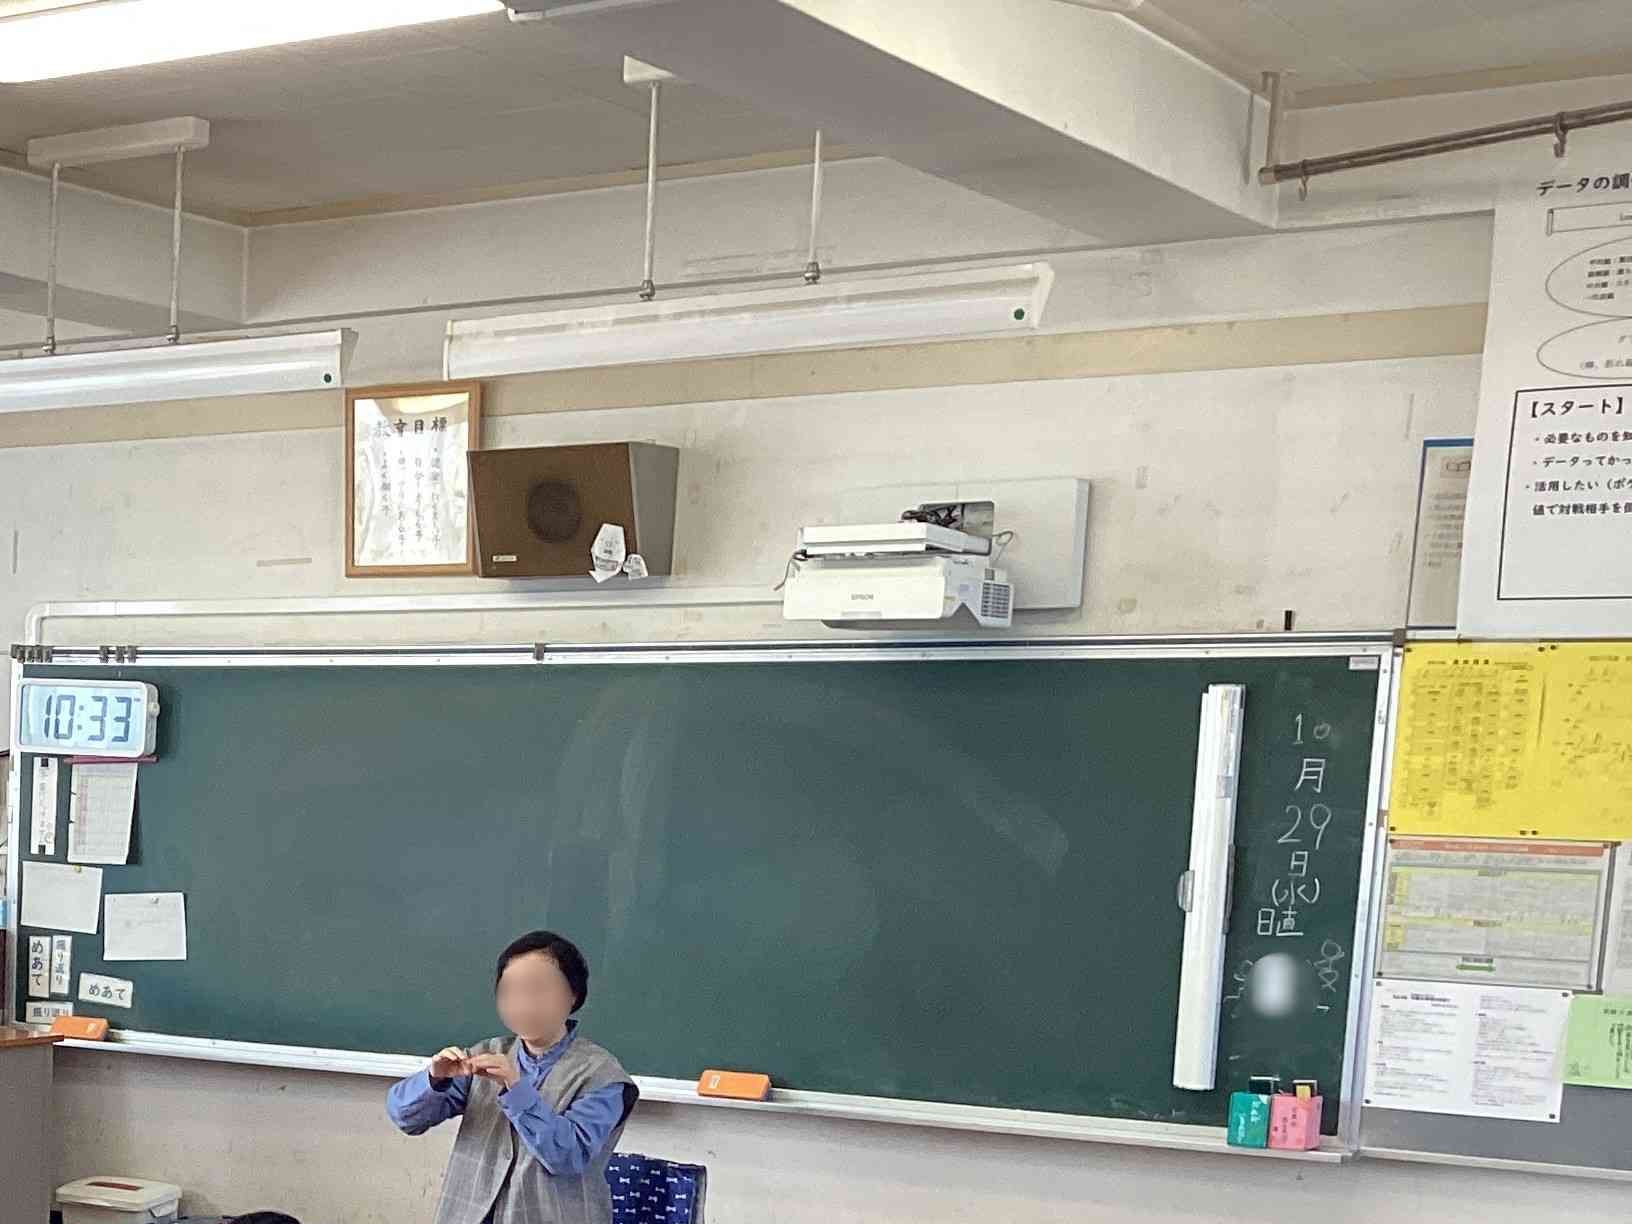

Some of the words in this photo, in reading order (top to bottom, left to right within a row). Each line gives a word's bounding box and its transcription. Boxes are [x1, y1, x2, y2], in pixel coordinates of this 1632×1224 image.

[1530, 396, 1624, 419] 【スタート】
[44, 694, 132, 742] 10:33
[1257, 906, 1304, 936] 日直
[31, 940, 44, 986] めあて
[88, 983, 127, 1001] めあて
